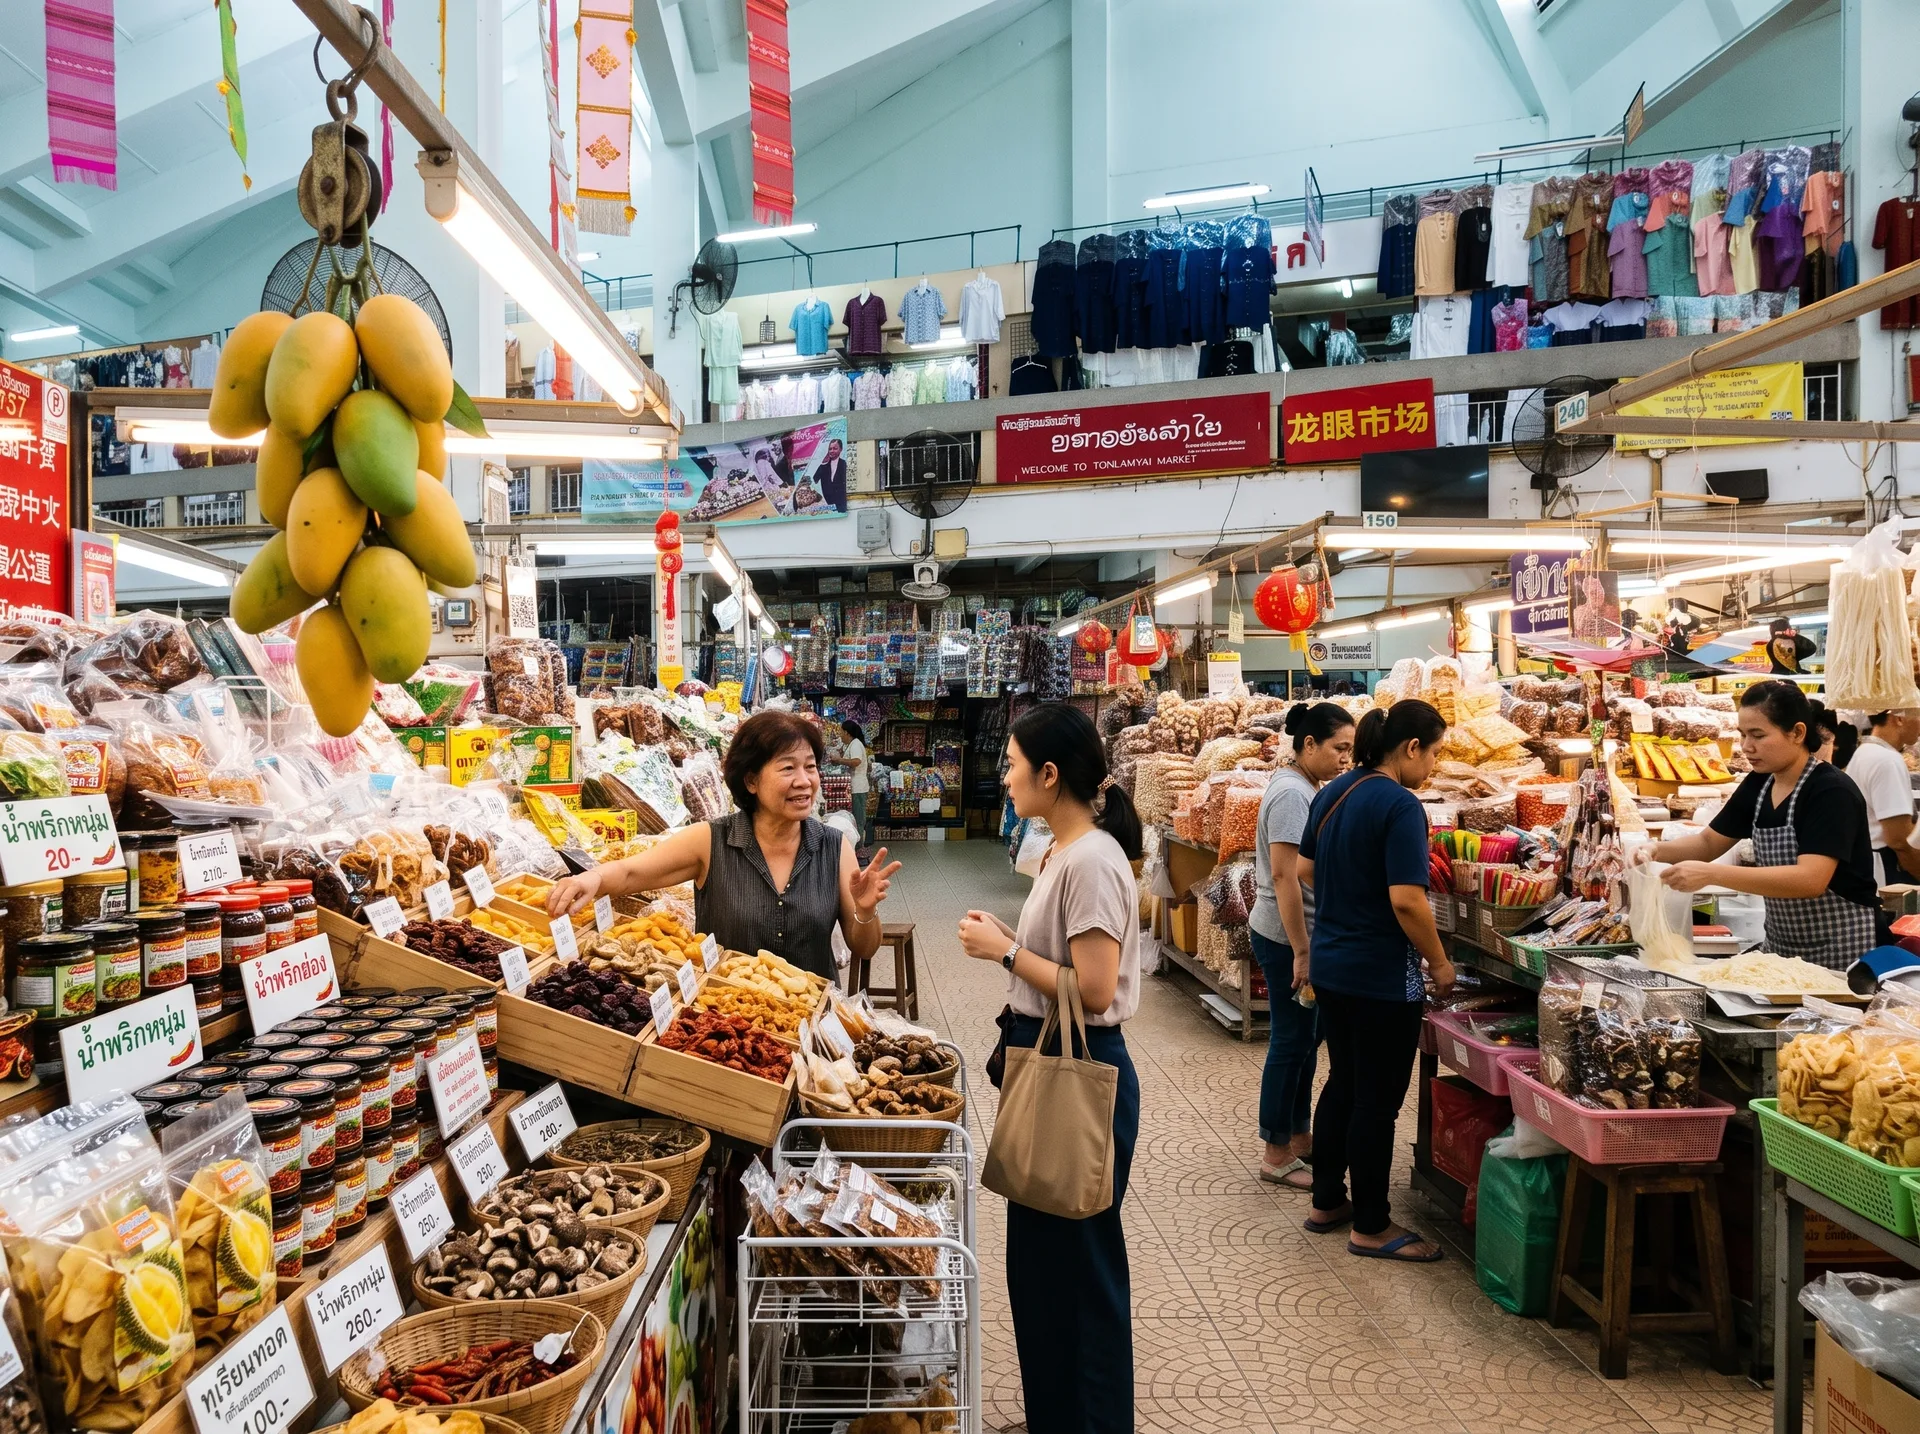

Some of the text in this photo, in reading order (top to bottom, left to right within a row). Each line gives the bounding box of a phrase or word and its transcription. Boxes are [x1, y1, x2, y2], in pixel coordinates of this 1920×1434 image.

[1286, 402, 1429, 446] 龙眼市场
[1559, 398, 1585, 424] 240
[1021, 454, 1197, 475] WELCOME TO TONLAMYAI MARKET
[1366, 513, 1395, 528] 150
[2, 803, 110, 844] น้ำพริกหนุ่ม
[77, 1004, 187, 1070] น้ำพริกหนุ่ม
[316, 1264, 387, 1326] น้ำพริกหนุ่ม
[345, 1306, 382, 1343] 260.-
[200, 1325, 289, 1420] ทุเรียนทอด
